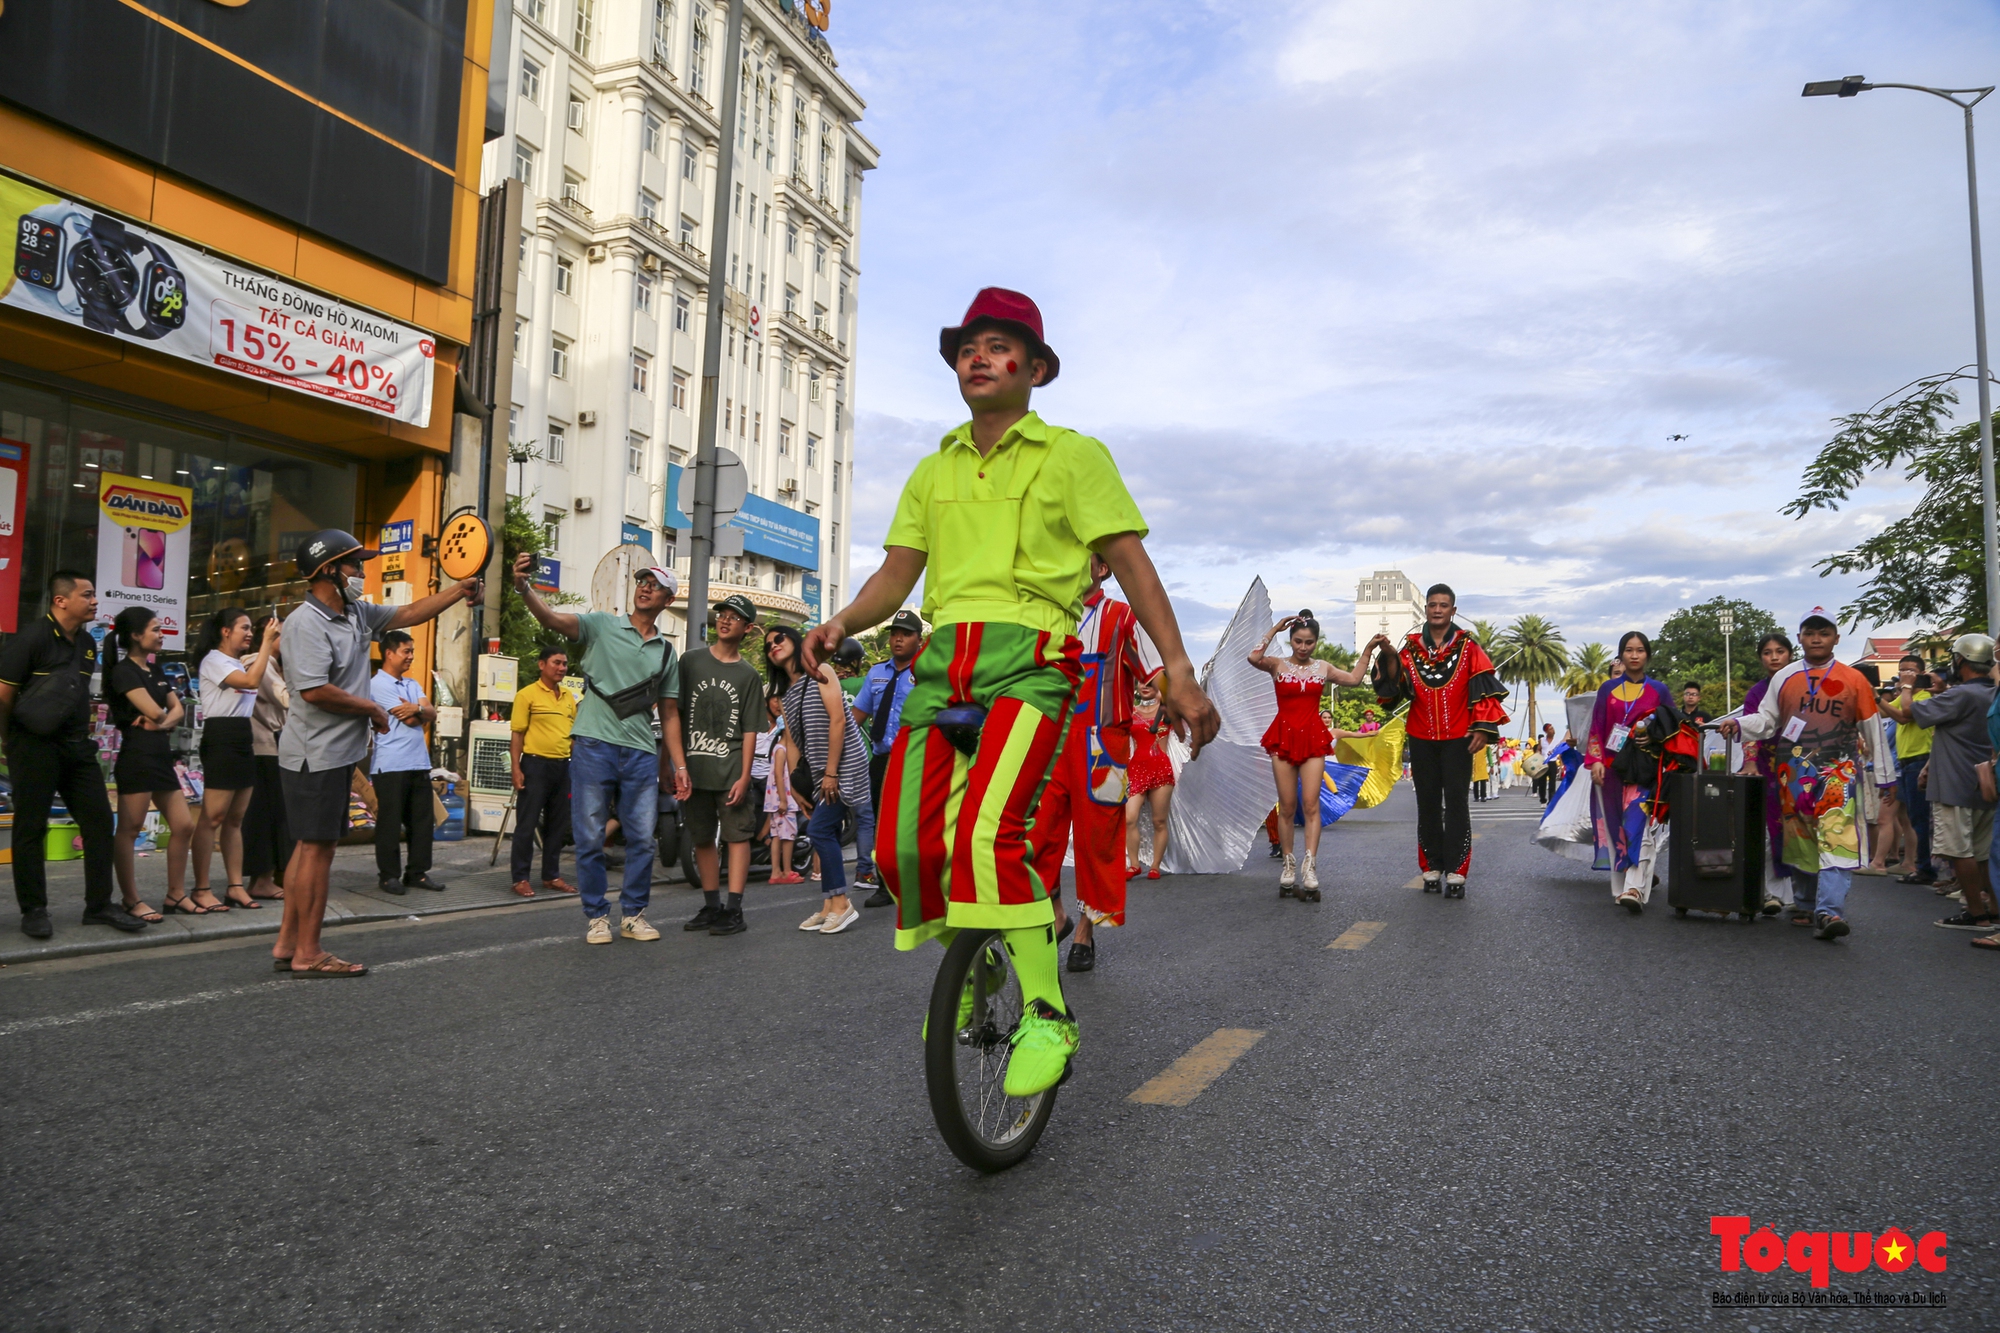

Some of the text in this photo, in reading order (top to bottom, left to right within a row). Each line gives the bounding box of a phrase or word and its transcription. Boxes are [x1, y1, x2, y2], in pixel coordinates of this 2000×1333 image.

[22, 220, 40, 235] 09
[21, 233, 38, 248] 28
[222, 270, 399, 344] THÁNG ĐỒNG HỒ XIAOMI
[258, 306, 364, 354] TẤT CẢ GIẢM
[220, 319, 296, 372] 15%
[326, 354, 398, 400] 40%
[112, 590, 177, 605] iPhone 13 Series
[698, 680, 708, 691] IS
[711, 678, 716, 686] A
[720, 680, 740, 704] GREAT
[1800, 676, 1844, 717] I HUE
[729, 708, 739, 725] DAY
